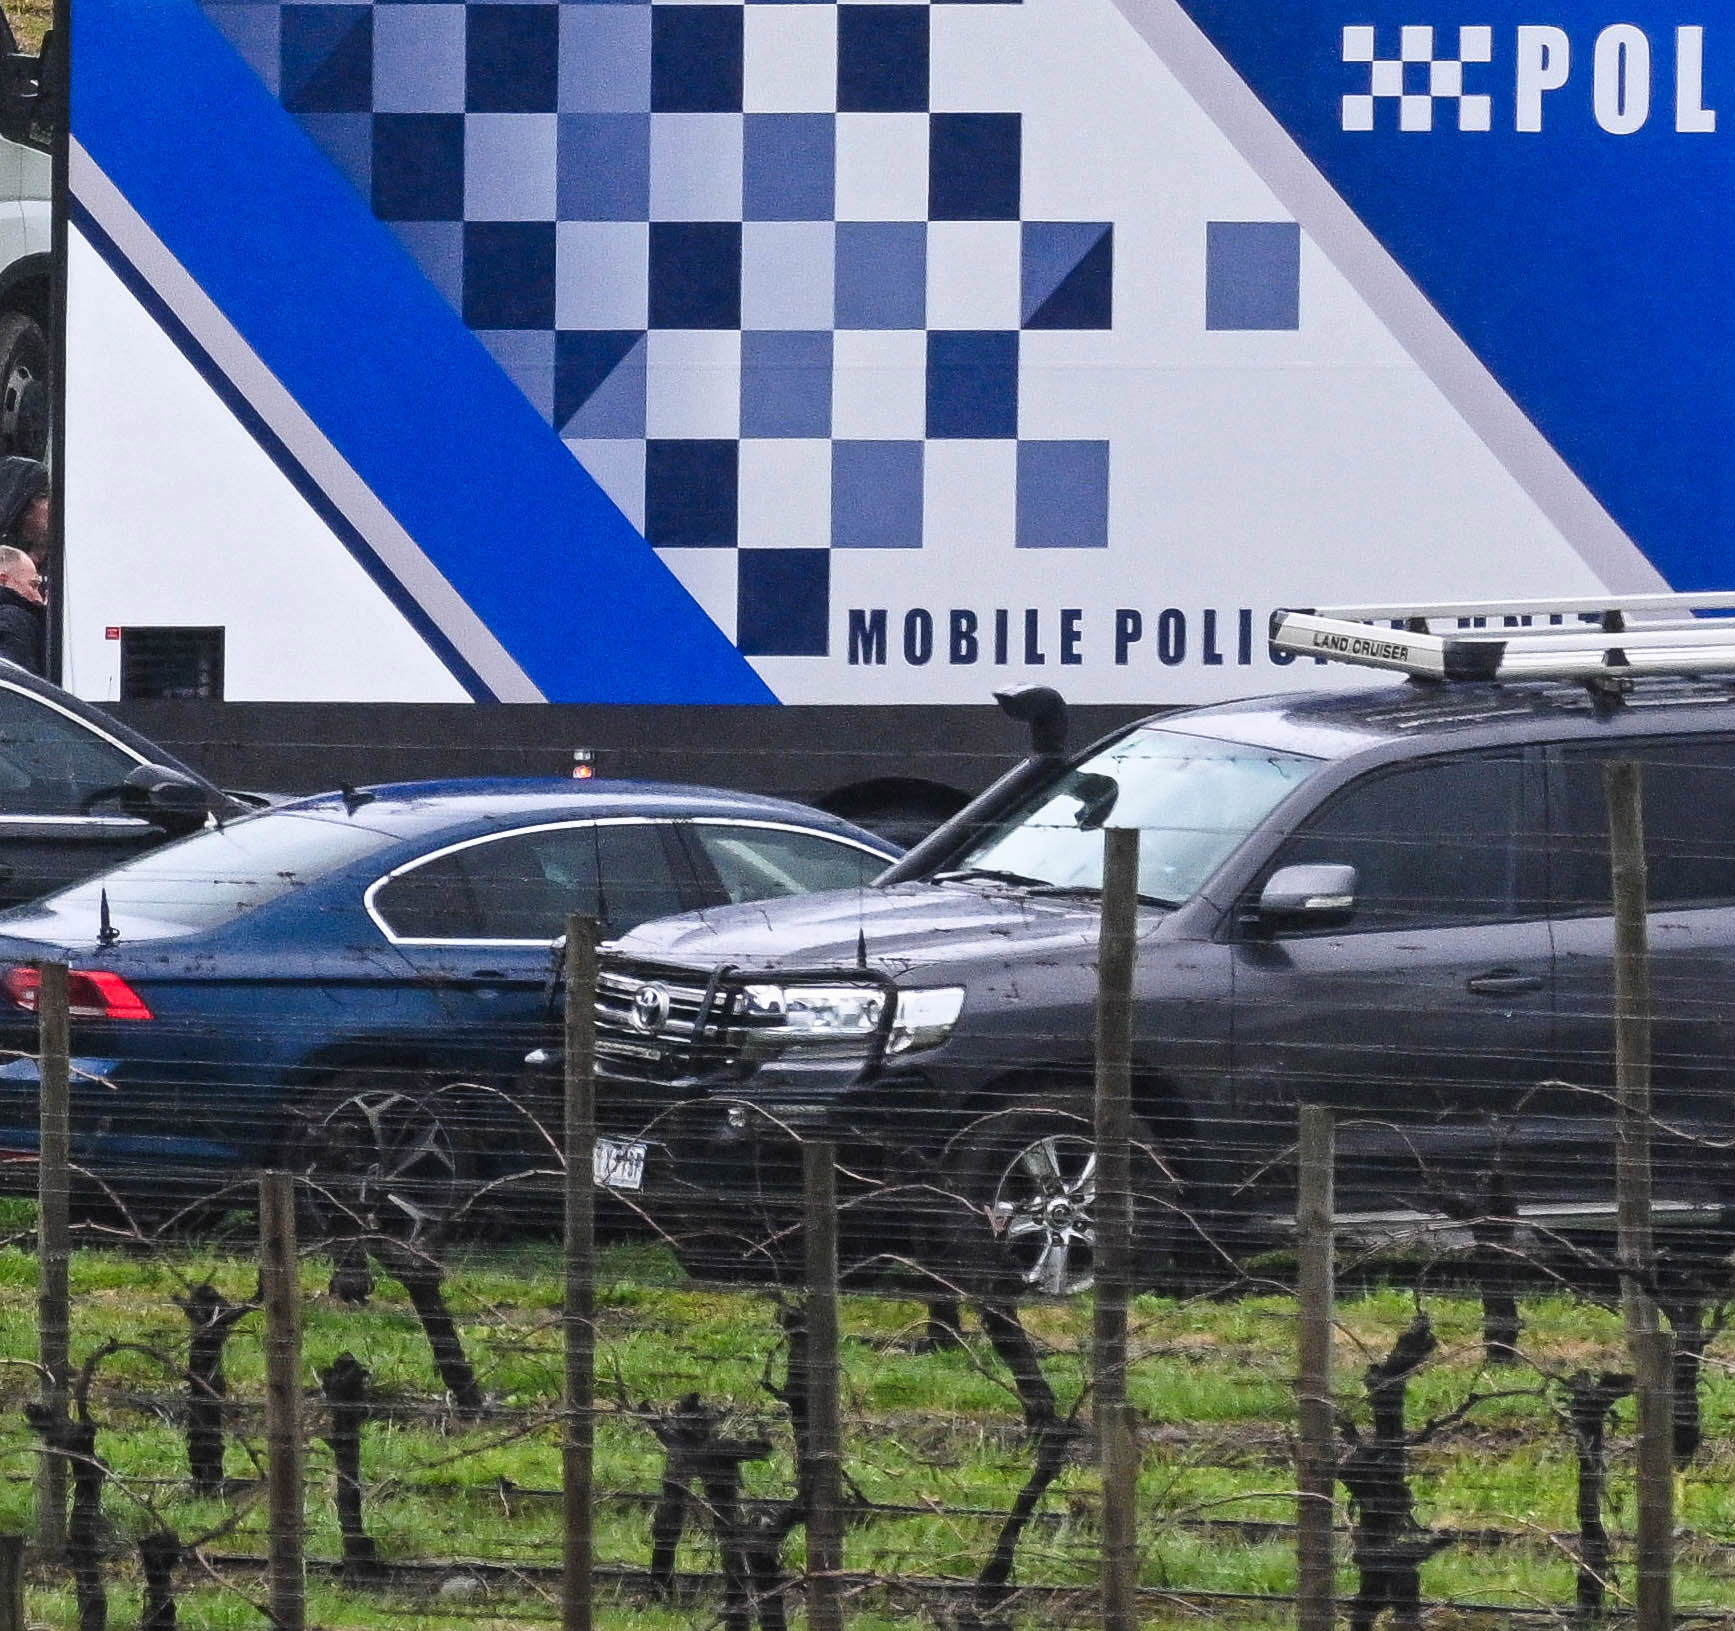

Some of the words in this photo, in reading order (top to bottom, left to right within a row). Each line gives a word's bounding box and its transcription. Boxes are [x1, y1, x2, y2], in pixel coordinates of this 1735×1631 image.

[847, 607, 1083, 667] MOBILE
[1312, 632, 1349, 654] LAND
[1351, 635, 1410, 662] CRUISER
